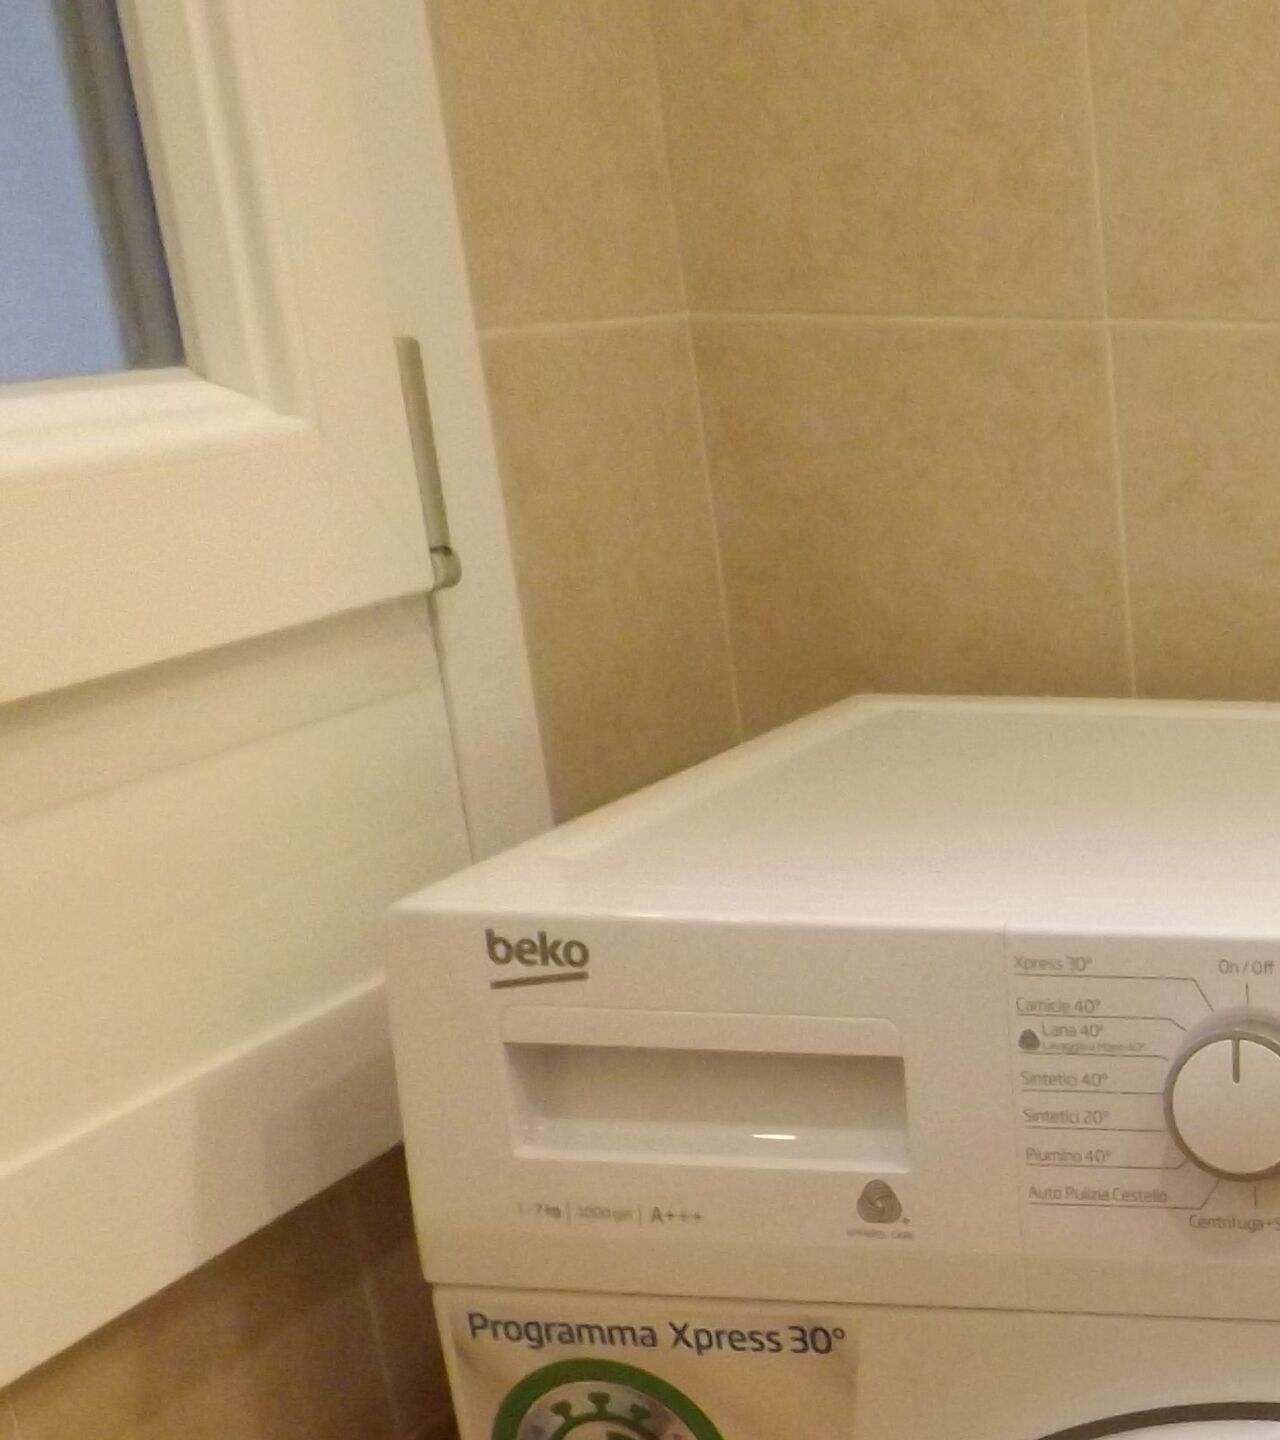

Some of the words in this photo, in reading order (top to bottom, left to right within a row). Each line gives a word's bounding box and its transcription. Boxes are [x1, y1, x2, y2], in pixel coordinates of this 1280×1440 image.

[485, 928, 590, 968] beko
[1014, 955, 1063, 972] Xpress
[1218, 959, 1240, 975] On
[1251, 960, 1275, 976] Off
[1016, 997, 1067, 1013] Camicie
[1073, 998, 1101, 1014] 40°
[1042, 1023, 1077, 1037] Lana
[1020, 1071, 1078, 1087] Sintetici
[1081, 1072, 1109, 1088] 40°
[1023, 1108, 1080, 1125] Sintetici
[1085, 1148, 1112, 1164] 40°
[1028, 1186, 1061, 1201] Auto
[1112, 1187, 1168, 1203] Cestello
[466, 1313, 657, 1349] Programma
[668, 1320, 782, 1354] Xpress
[788, 1325, 846, 1354] 30°
